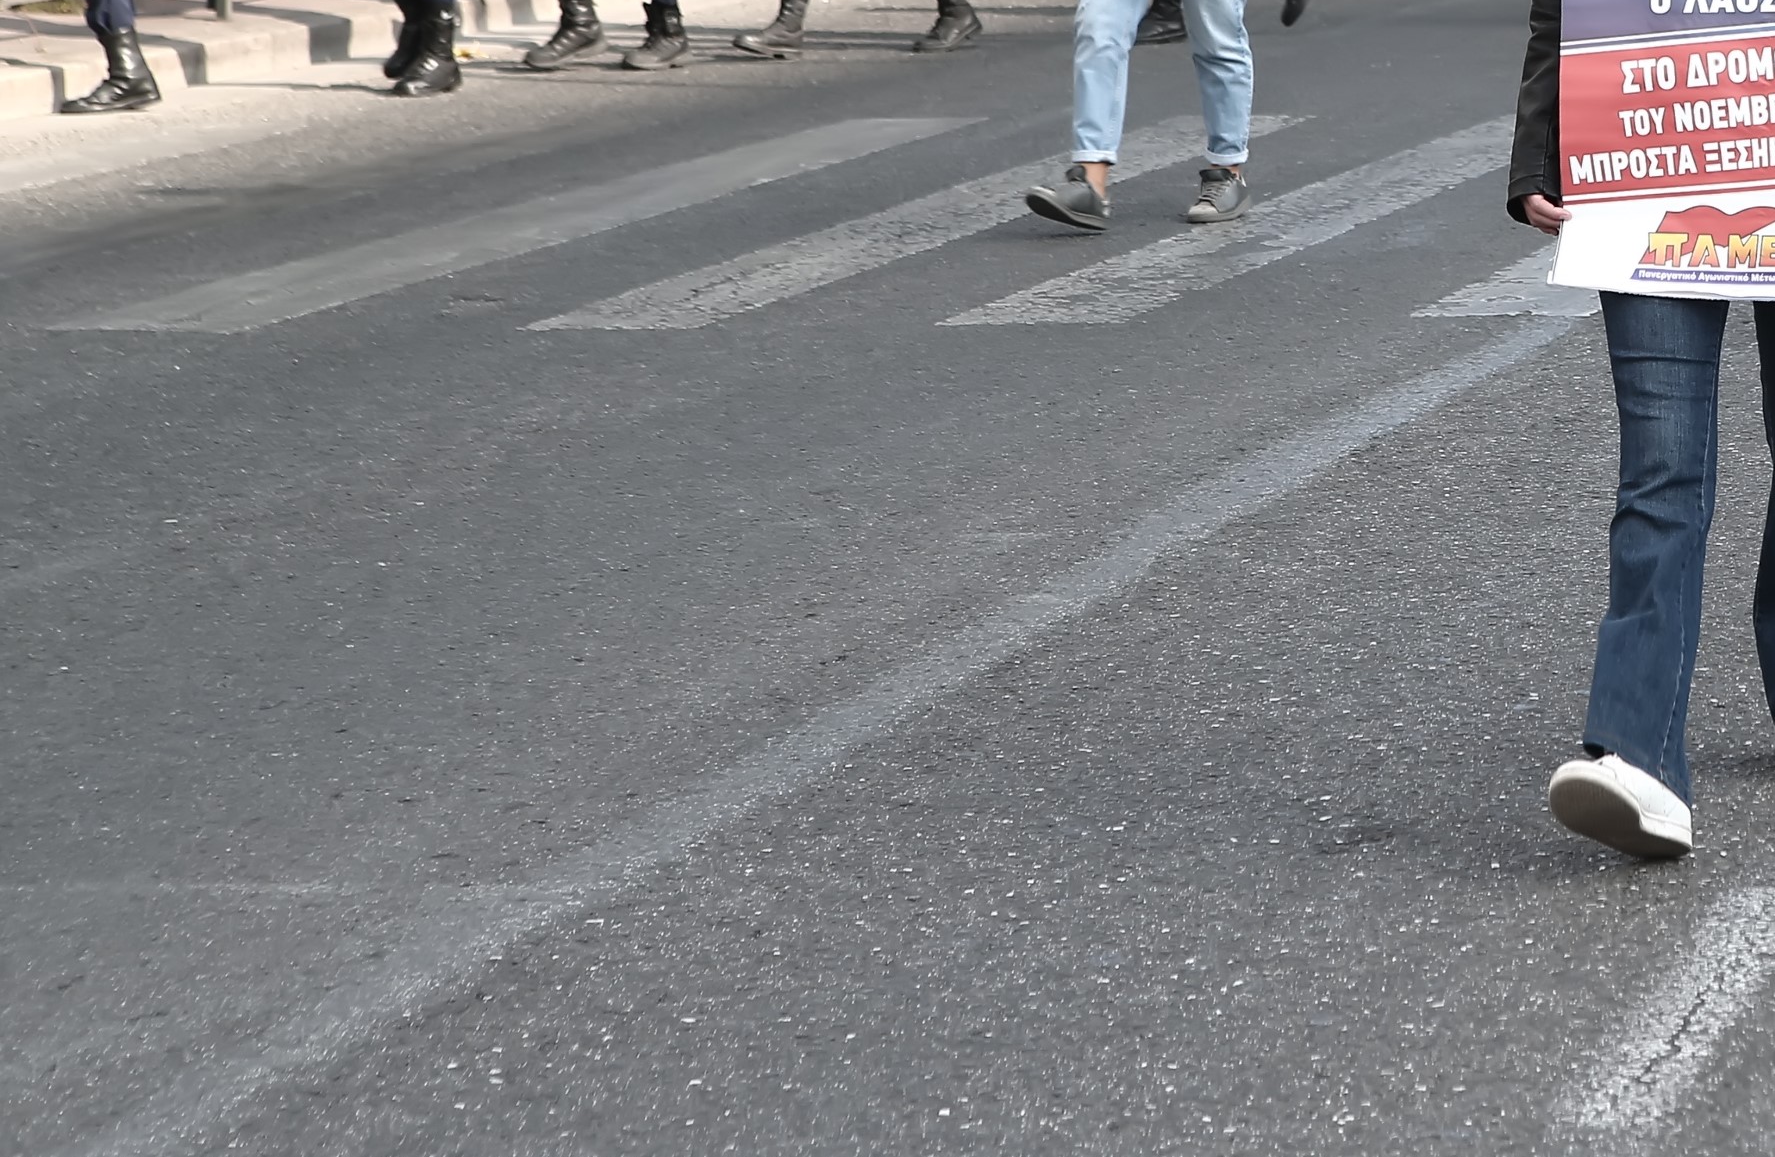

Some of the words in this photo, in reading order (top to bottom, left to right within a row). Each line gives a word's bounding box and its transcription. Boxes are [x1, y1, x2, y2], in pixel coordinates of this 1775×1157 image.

[1620, 56, 1677, 94] ΣΤΟ
[1619, 106, 1666, 137] ΤΟΥ
[1569, 144, 1698, 185] ΜΠΡΟΣΤΑ
[1639, 270, 1696, 281] Πανεργατικό
[1699, 273, 1749, 282] Αγωνιστικό
